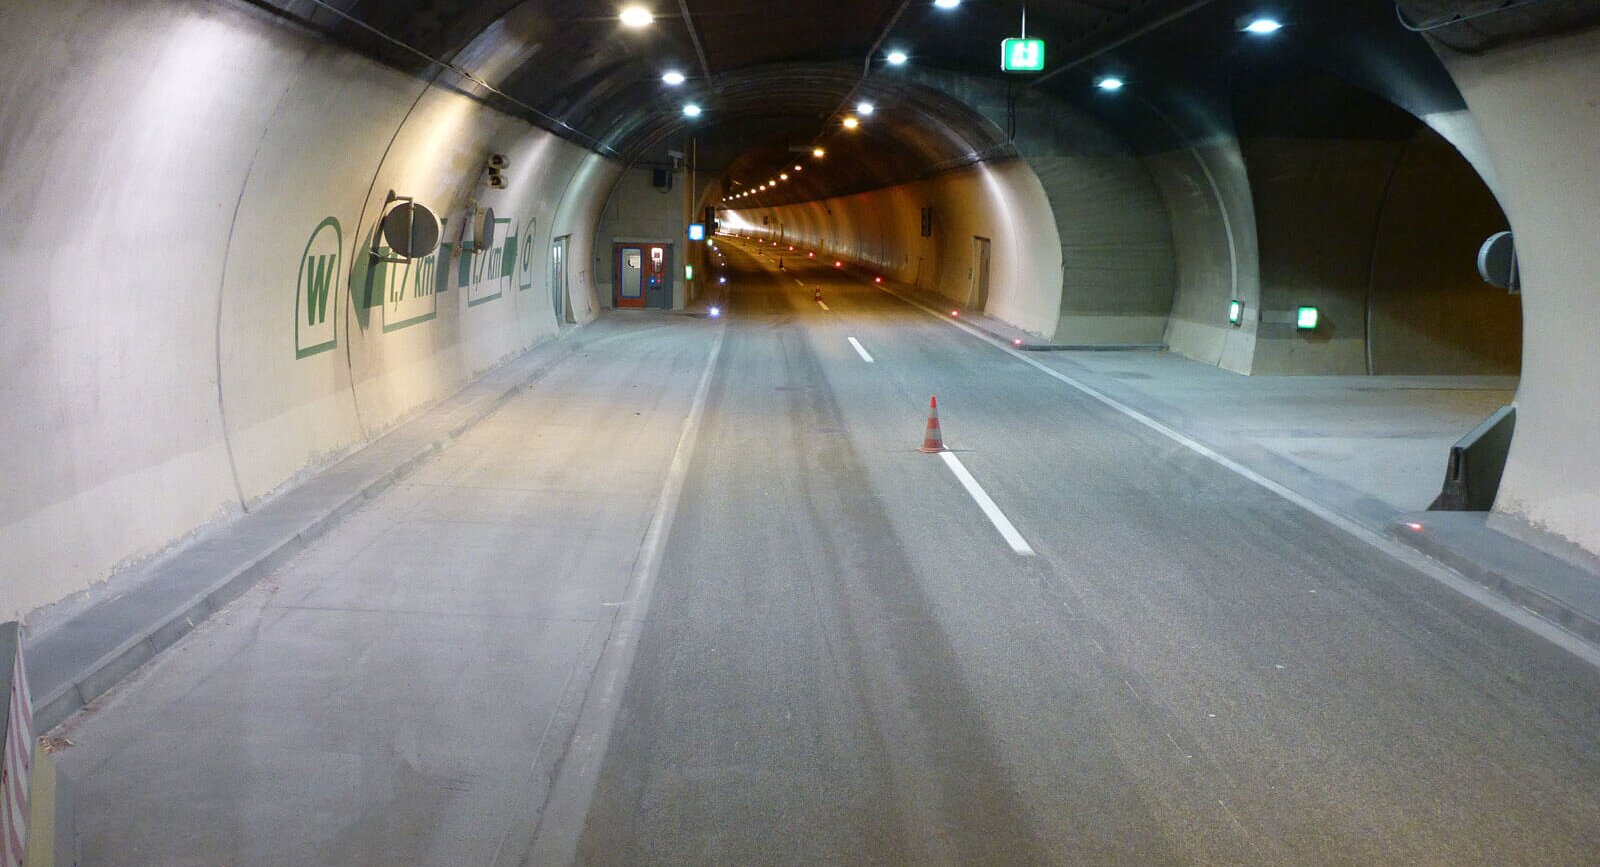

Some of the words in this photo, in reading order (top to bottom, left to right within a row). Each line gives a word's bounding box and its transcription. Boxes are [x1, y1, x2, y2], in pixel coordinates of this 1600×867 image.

[414, 256, 435, 298] km
[487, 246, 503, 281] km
[307, 253, 337, 326] W
